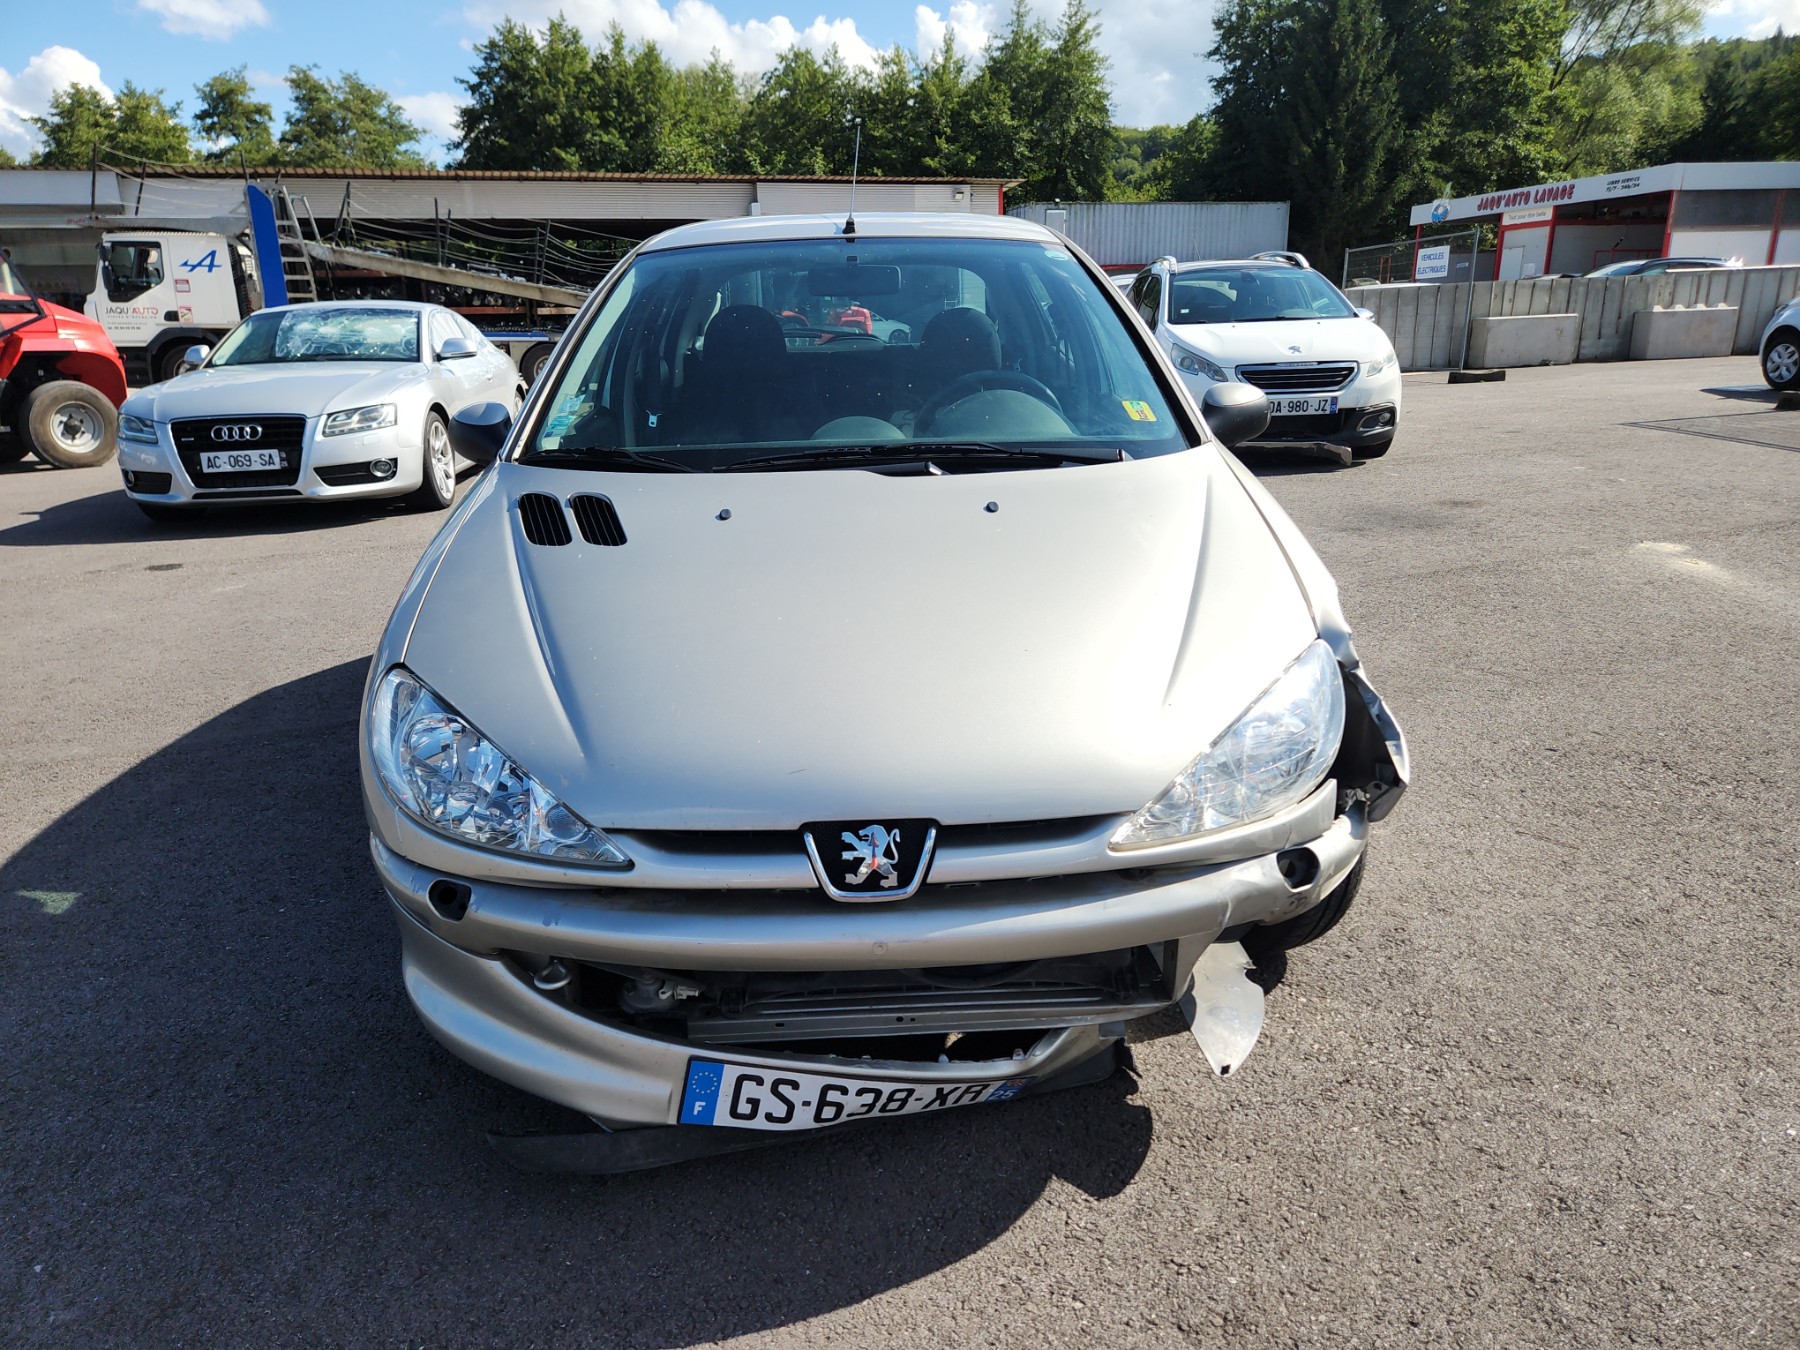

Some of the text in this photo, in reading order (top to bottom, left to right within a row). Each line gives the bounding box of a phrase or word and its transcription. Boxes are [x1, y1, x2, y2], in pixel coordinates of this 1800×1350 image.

[1477, 183, 1576, 211] JAQU'AUTO LAVAGE
[206, 453, 276, 469] AC-069-SA
[693, 1101, 706, 1116] F
[729, 1073, 992, 1125] GS-638-XR
